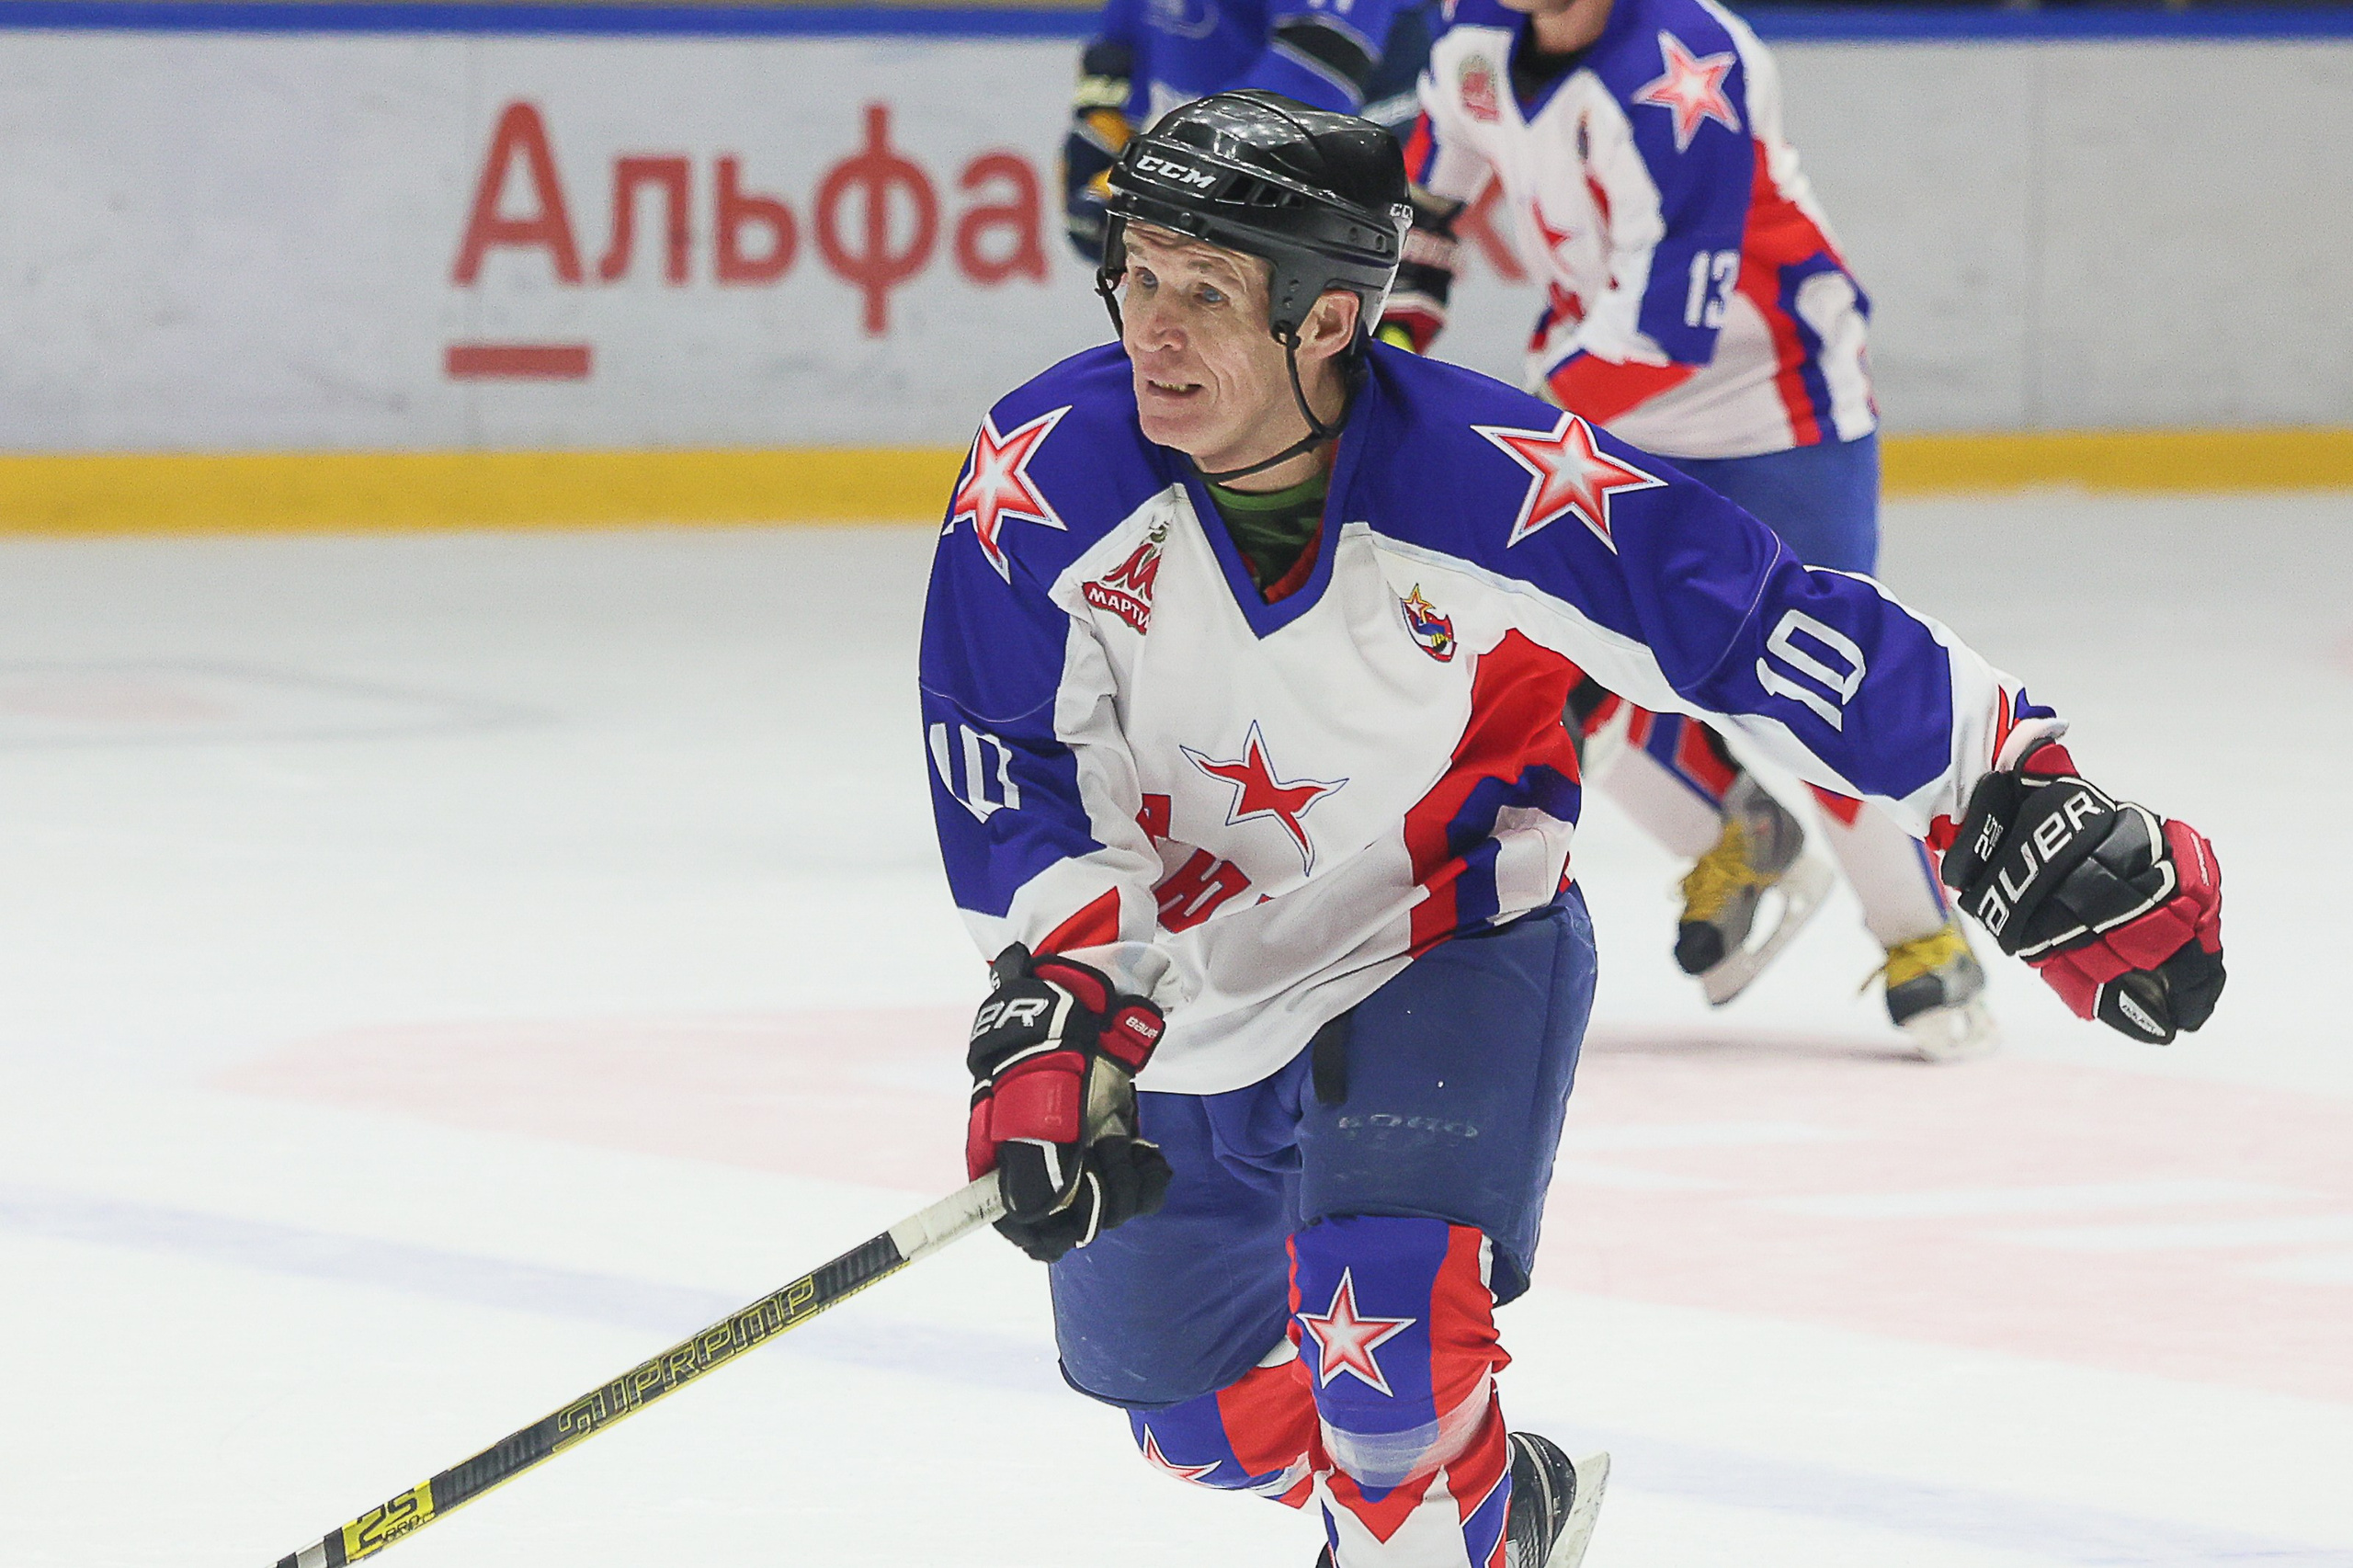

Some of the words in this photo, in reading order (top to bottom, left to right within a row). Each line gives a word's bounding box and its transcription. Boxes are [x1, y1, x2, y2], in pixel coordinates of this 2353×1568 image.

[451, 100, 1048, 336] Альфа
[1136, 154, 1217, 189] CCM
[1684, 249, 1741, 329] 13
[1756, 609, 1867, 733] 10
[1977, 790, 2105, 937] AUER
